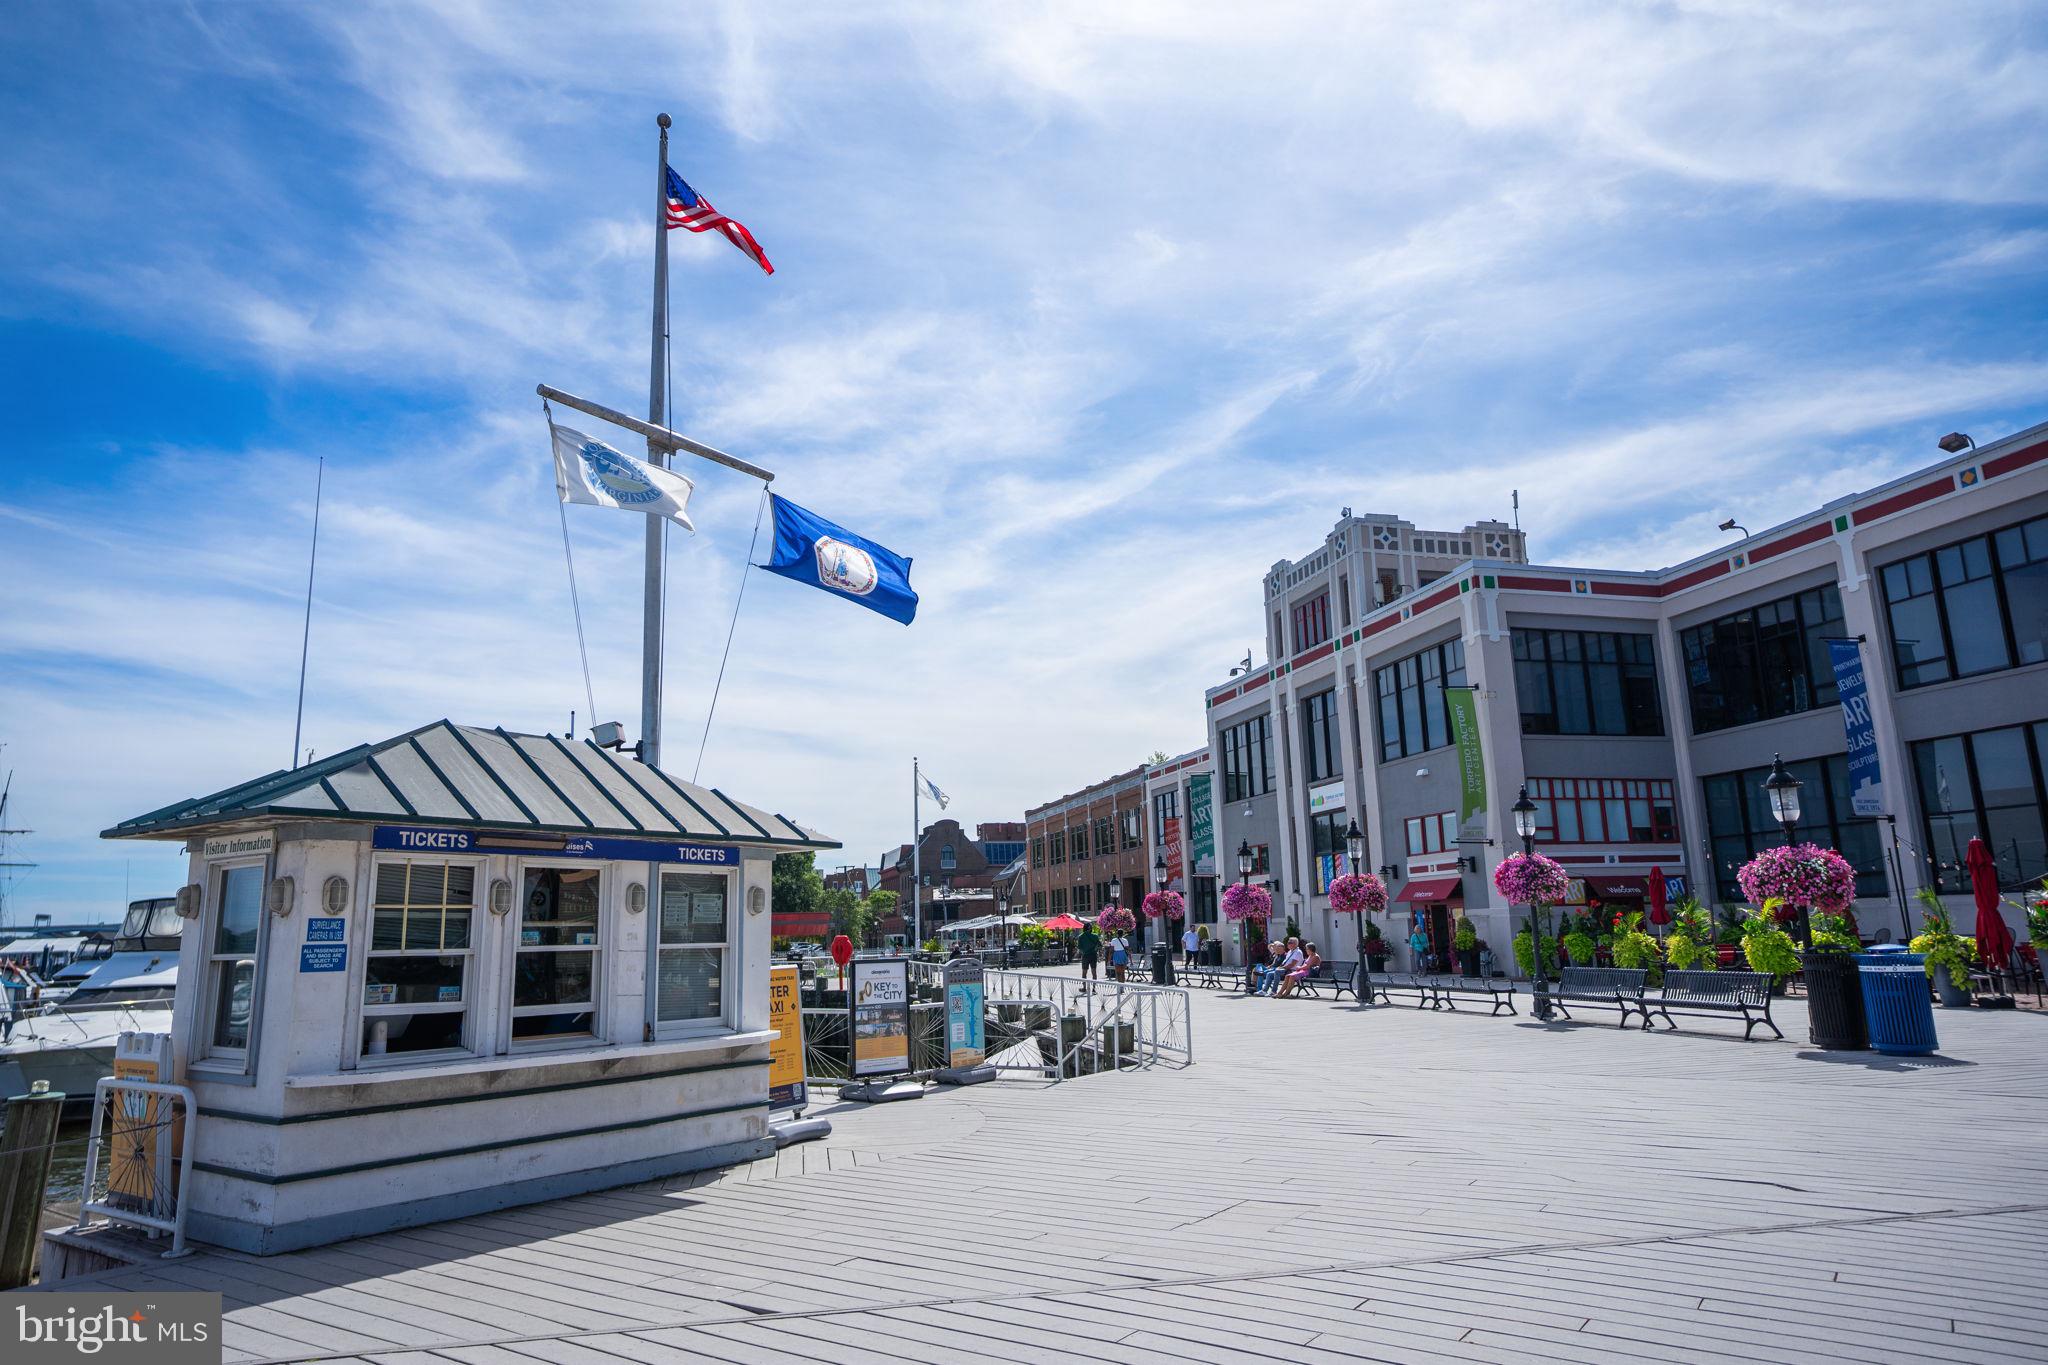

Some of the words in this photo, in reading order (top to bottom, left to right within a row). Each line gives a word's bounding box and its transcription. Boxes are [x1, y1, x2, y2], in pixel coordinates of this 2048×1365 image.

[1841, 692, 1871, 730] ART
[1455, 704, 1470, 745] FACTORY
[1468, 726, 1480, 770] CENTER
[1847, 729, 1876, 753] GLASS
[1464, 749, 1475, 794] TORPEDO
[1191, 804, 1213, 826] ART
[399, 831, 468, 848] TICKETS
[1192, 826, 1213, 841] GLASS
[205, 841, 228, 856] Visitor
[229, 836, 272, 853] Information
[678, 847, 726, 862] TICKETS
[1166, 840, 1181, 857] ART
[1606, 885, 1642, 894] Welcome
[770, 985, 790, 998] TER
[873, 982, 891, 992] KEY
[883, 990, 903, 1000] CITY
